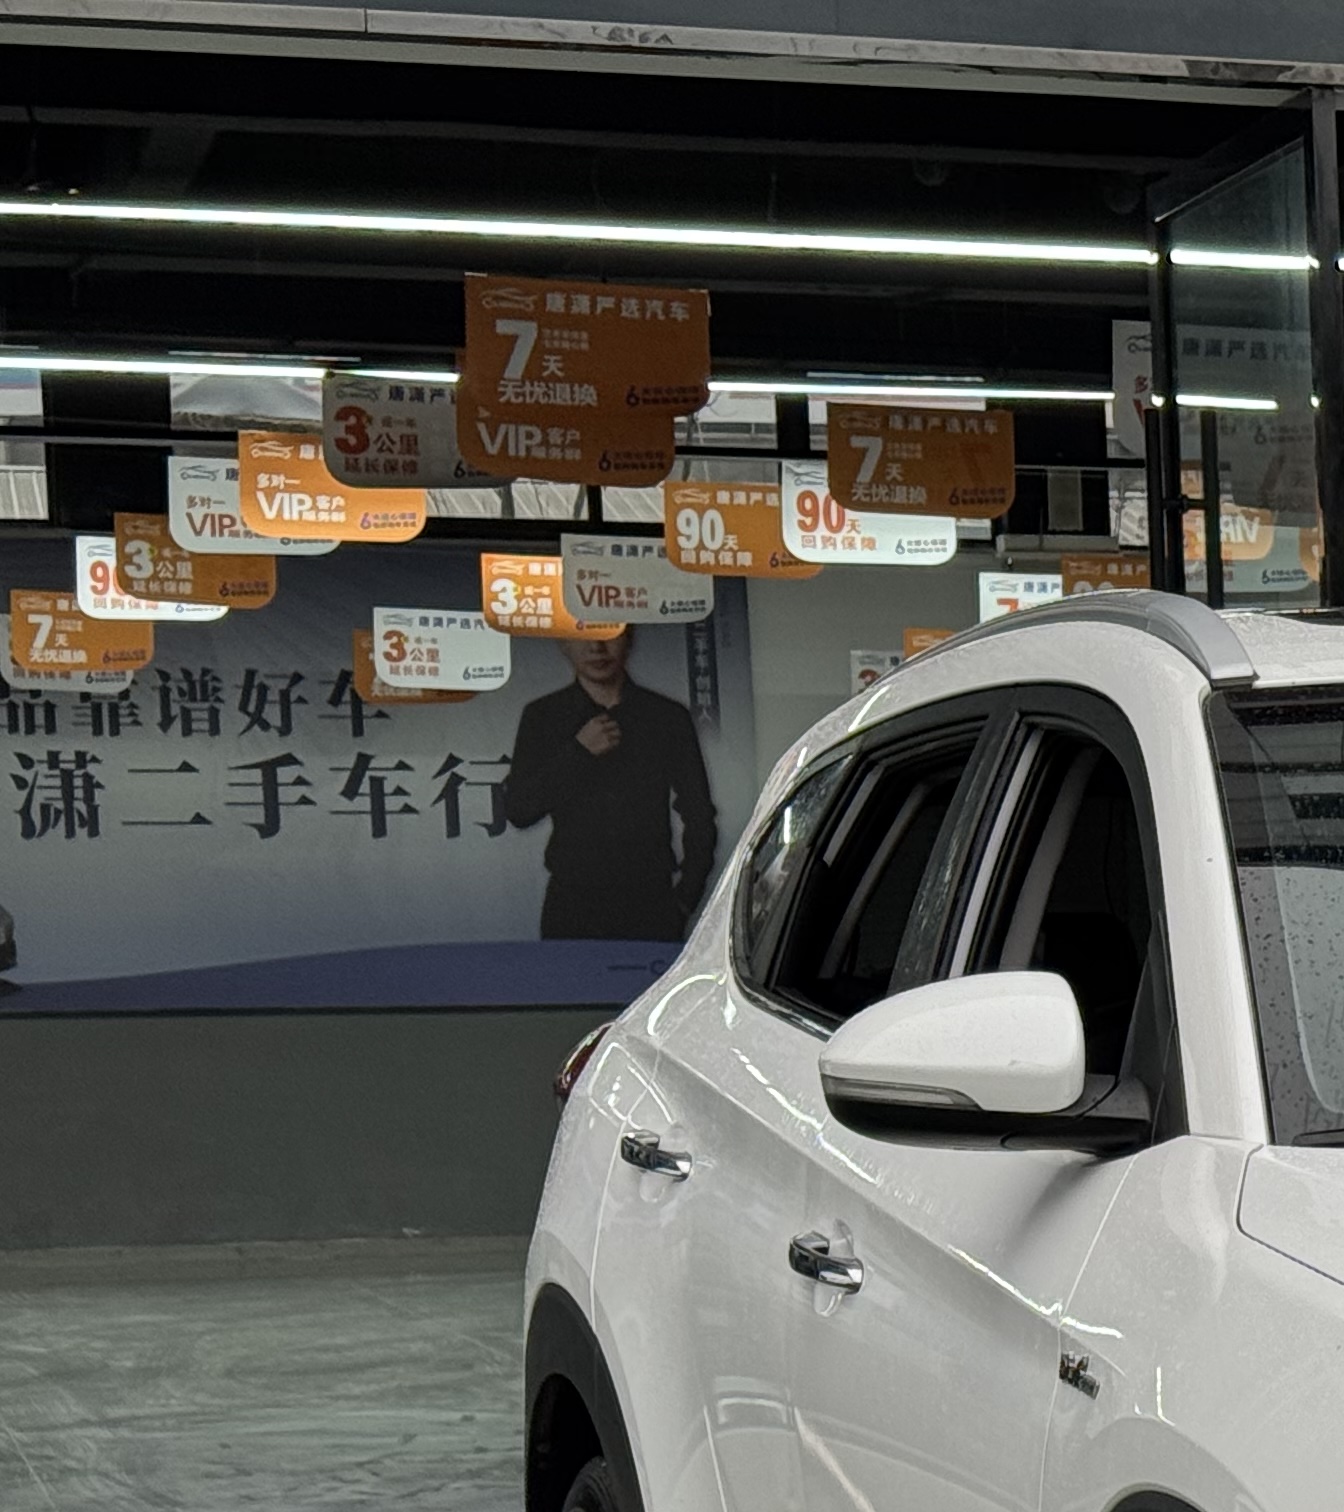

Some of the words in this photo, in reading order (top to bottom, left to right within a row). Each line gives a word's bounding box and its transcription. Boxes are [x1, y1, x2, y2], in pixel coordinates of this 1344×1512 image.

[546, 291, 690, 321] 唐潇严选汽车
[495, 319, 538, 379] 7
[542, 355, 565, 377] 天
[389, 384, 456, 404] 唐潇严
[498, 380, 598, 406] 无忧退换
[334, 405, 370, 455] 3
[373, 432, 421, 459] 公里
[476, 421, 543, 456] VIP
[850, 436, 883, 482] 7
[885, 462, 902, 481] 天
[256, 473, 301, 489] 多对一
[186, 495, 226, 509] 多对一
[255, 491, 312, 522] VIP
[316, 495, 346, 508] 客户
[851, 484, 928, 505] 无忧退换
[185, 512, 237, 538] VIP
[800, 534, 877, 551] 回购保障
[156, 560, 194, 580] 公里
[680, 550, 753, 568] 回购保障
[576, 569, 611, 581] 多对一
[520, 598, 553, 615] 公里
[576, 584, 621, 608] VIP
[28, 614, 53, 649] 7
[383, 630, 406, 662] 3
[409, 648, 441, 664] 公里
[10, 749, 511, 841] 潇二手车行
